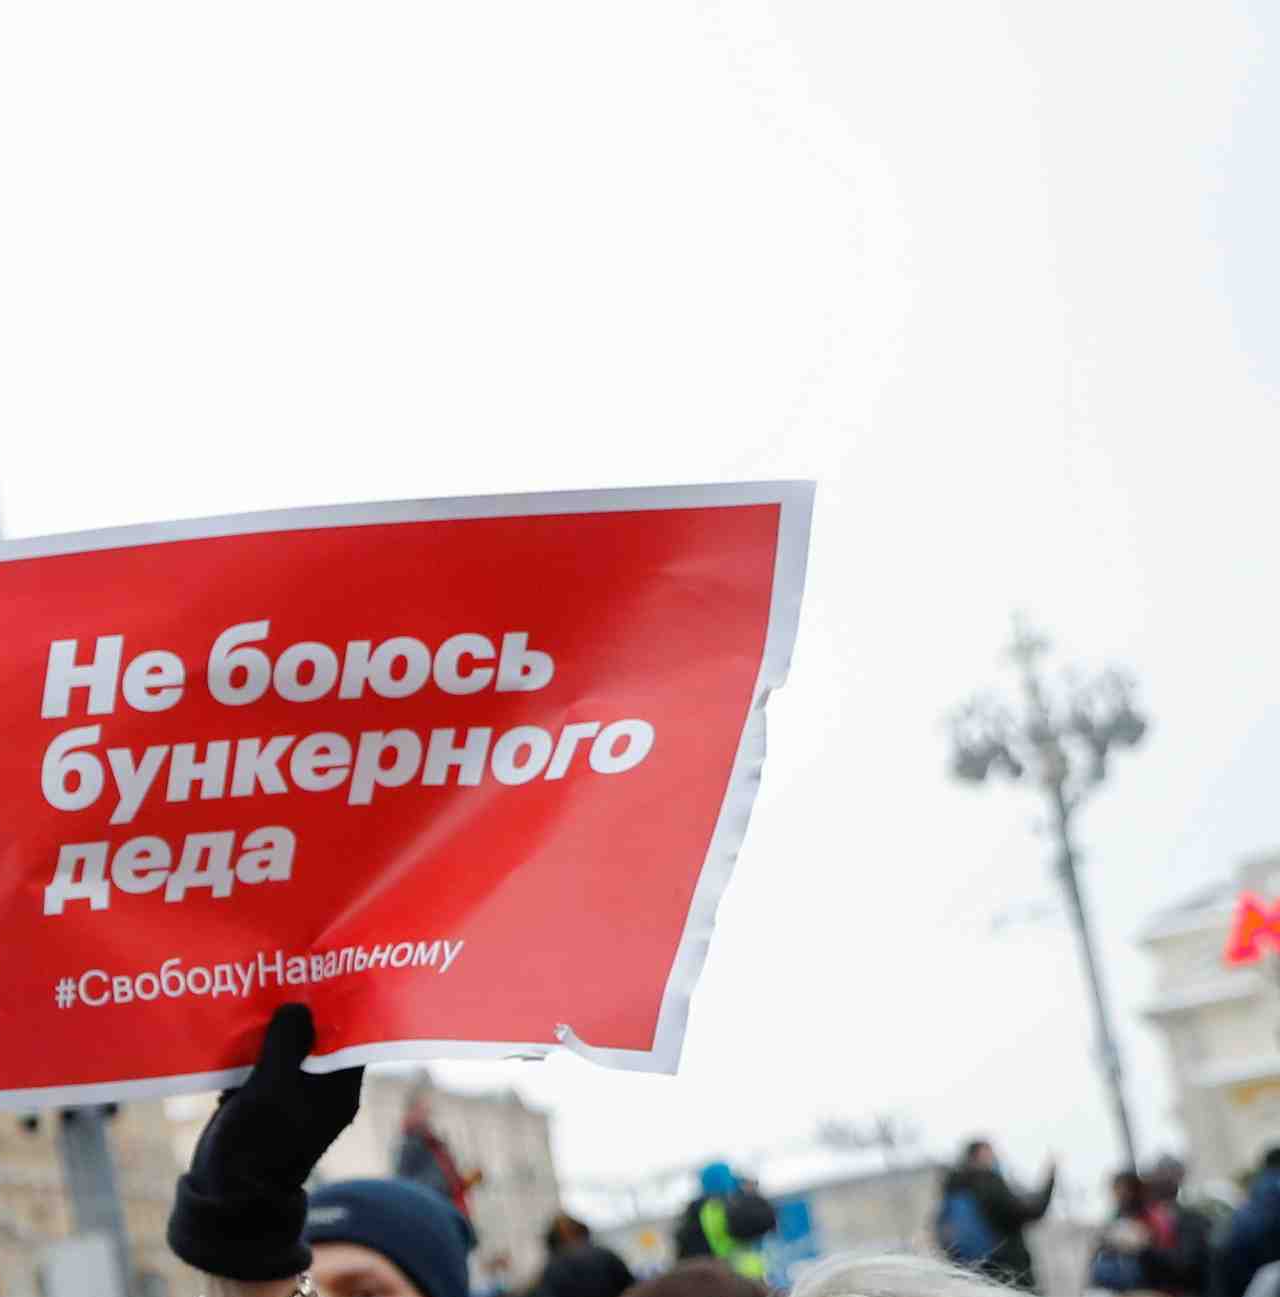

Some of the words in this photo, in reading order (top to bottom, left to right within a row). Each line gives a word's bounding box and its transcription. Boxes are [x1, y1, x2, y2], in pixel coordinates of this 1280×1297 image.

[41, 634, 186, 719] Не
[207, 620, 554, 705] боюсь
[41, 717, 657, 824] бункерного
[43, 826, 295, 916] деда
[55, 937, 467, 1009] #СвободуНавальному
